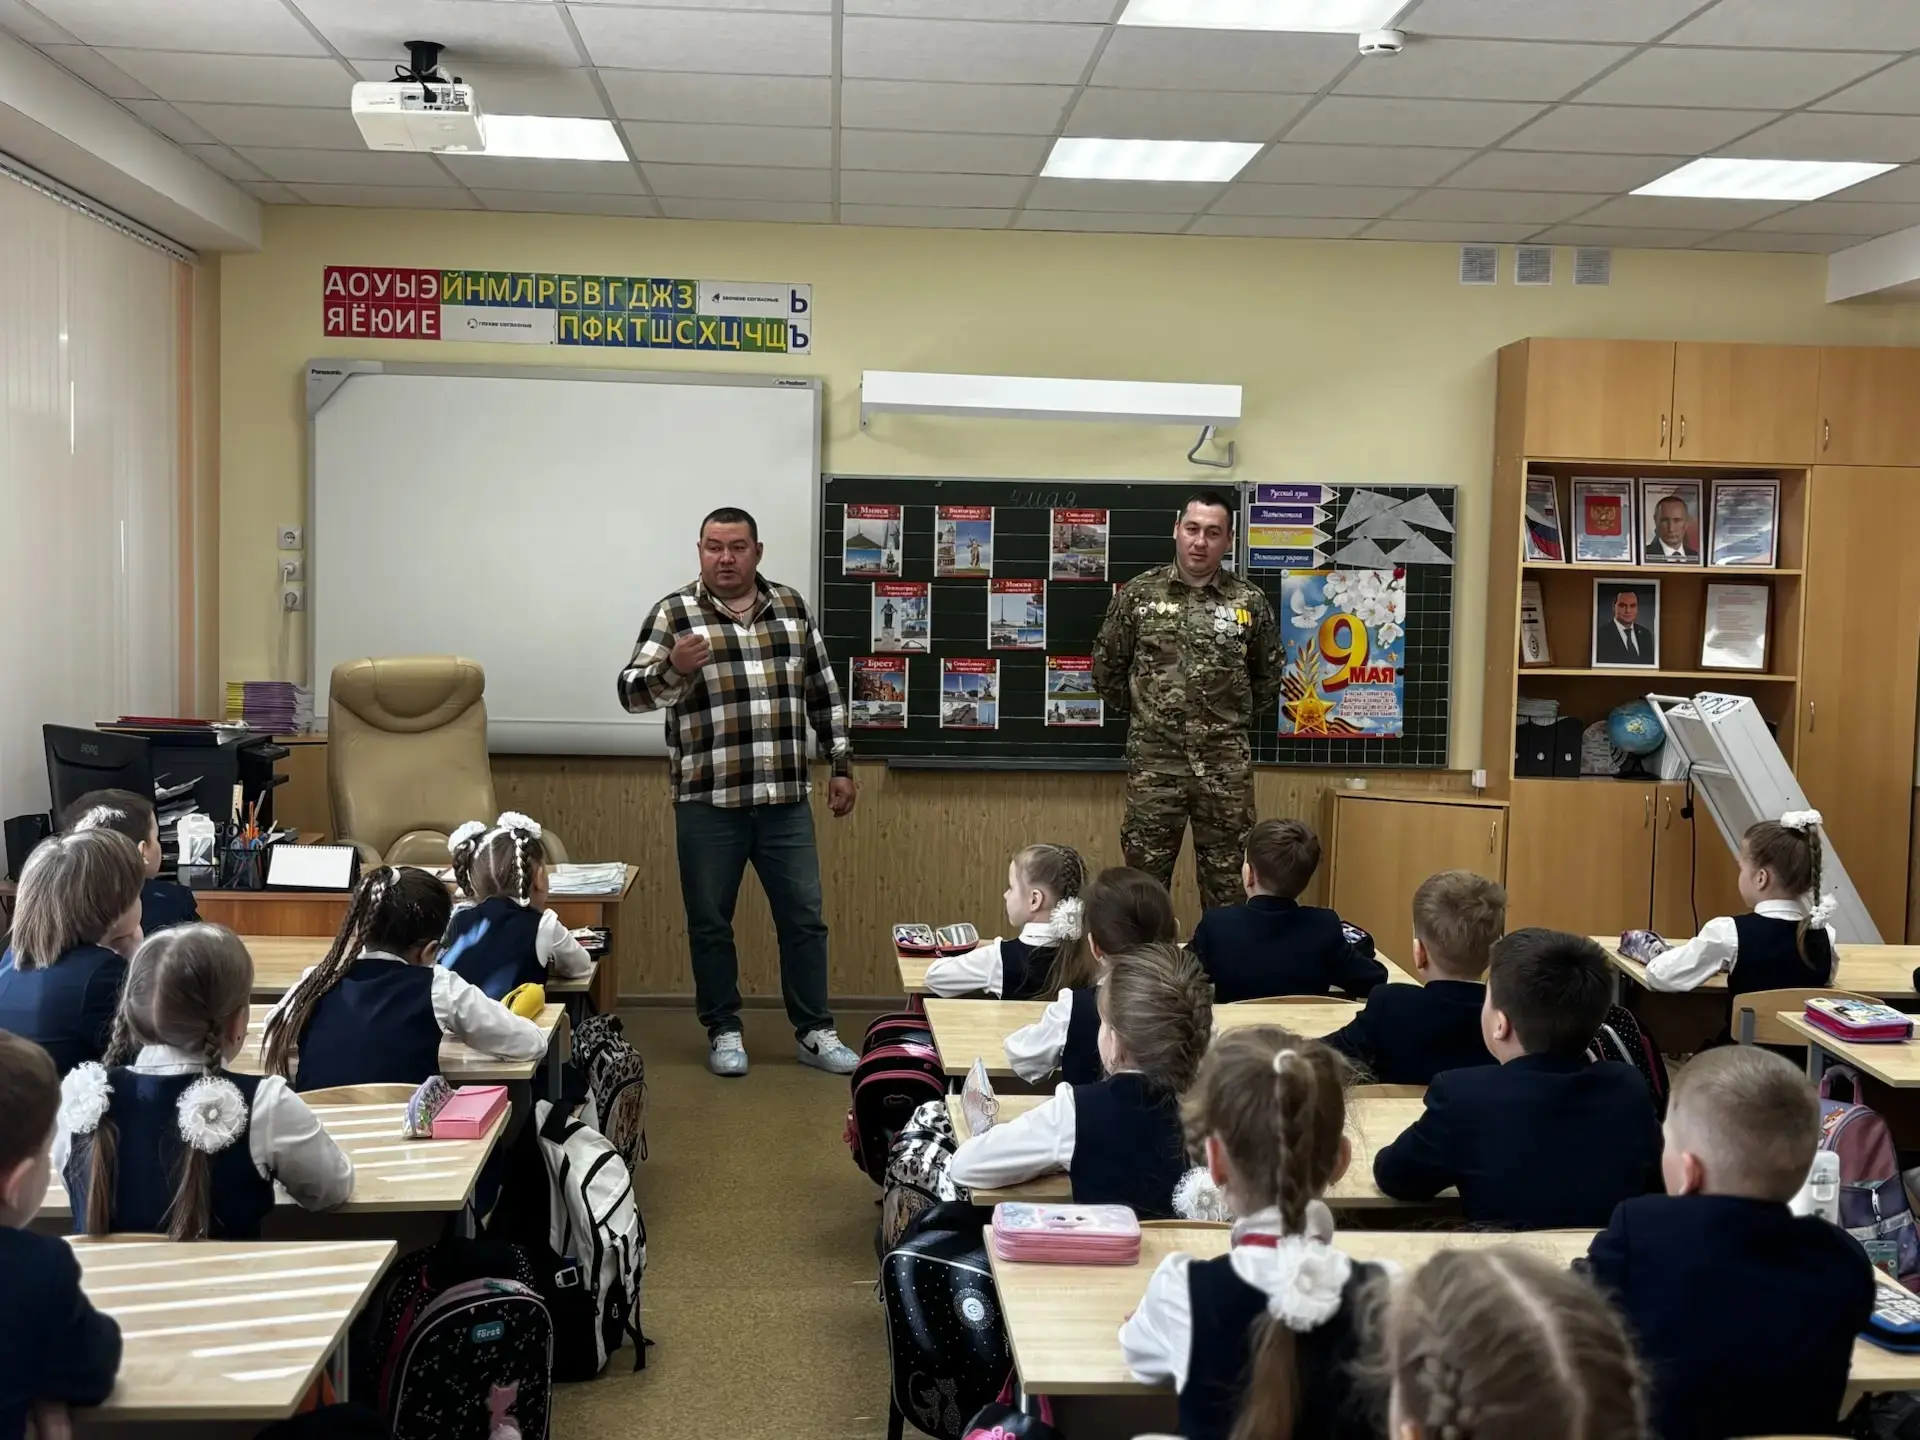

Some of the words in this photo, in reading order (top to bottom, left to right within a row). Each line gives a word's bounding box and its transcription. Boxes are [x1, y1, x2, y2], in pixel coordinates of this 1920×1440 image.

[1318, 612, 1369, 693] 9
[867, 659, 894, 669] Брест
[1348, 665, 1396, 685] МАЯ
